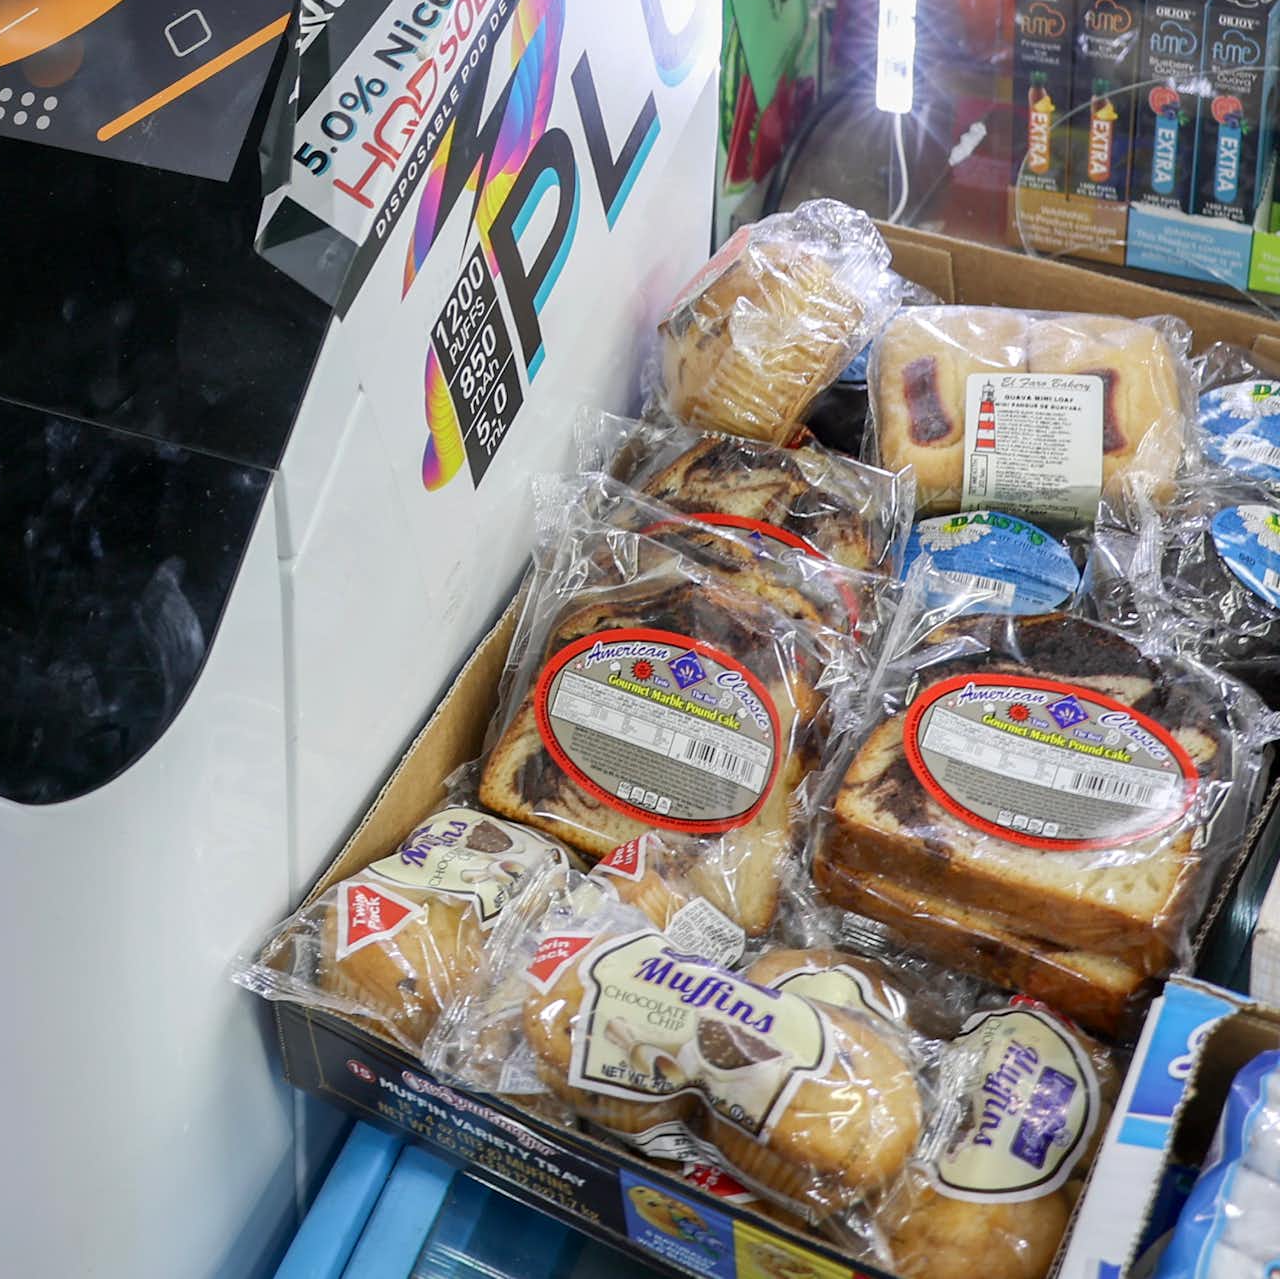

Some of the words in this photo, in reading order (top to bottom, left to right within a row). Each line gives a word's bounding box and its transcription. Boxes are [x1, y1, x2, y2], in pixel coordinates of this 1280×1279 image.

[1156, 6, 1192, 20] ORJOY
[1219, 15, 1255, 30] ORJOY
[293, 73, 389, 177] 5.0%
[333, 59, 439, 209] HQD
[375, 90, 460, 240] DISPOSABLE
[460, 33, 489, 86] POD
[1030, 112, 1049, 167] EXTRA
[1090, 121, 1110, 175] EXTRA
[1154, 128, 1175, 183] EXTRA
[1217, 137, 1238, 193] EXTRA
[436, 256, 484, 350] 1200
[448, 296, 486, 365] PUFFS
[460, 324, 496, 400] 850
[470, 358, 500, 414] mAh
[1051, 378, 1092, 392] Bakery
[476, 382, 508, 447] 5.0
[485, 418, 507, 456] mL
[585, 641, 671, 669] American
[716, 670, 770, 729] Classic
[608, 673, 650, 698] Gourmet
[651, 689, 684, 710] Marble
[685, 702, 718, 721] Pound
[956, 682, 1048, 706] American
[1098, 711, 1169, 761] Classic
[983, 714, 1028, 736] Gourmet
[1031, 730, 1066, 748] Marble
[1068, 738, 1103, 757] Pound
[352, 891, 369, 926] Twin
[367, 895, 382, 931] Pack
[604, 985, 690, 1020] CHOCOLATE
[634, 958, 776, 1033] Muffins
[647, 1010, 687, 1032] CHIP
[349, 1062, 371, 1080] 15
[601, 1064, 624, 1078] NET
[378, 1102, 405, 1122] NET
[410, 1121, 433, 1137] WT
[379, 1077, 448, 1120] MUFFIN
[451, 1114, 531, 1161] VARIETY
[534, 1156, 587, 1187] TRAY
[505, 1156, 574, 1196] MUFFINS
